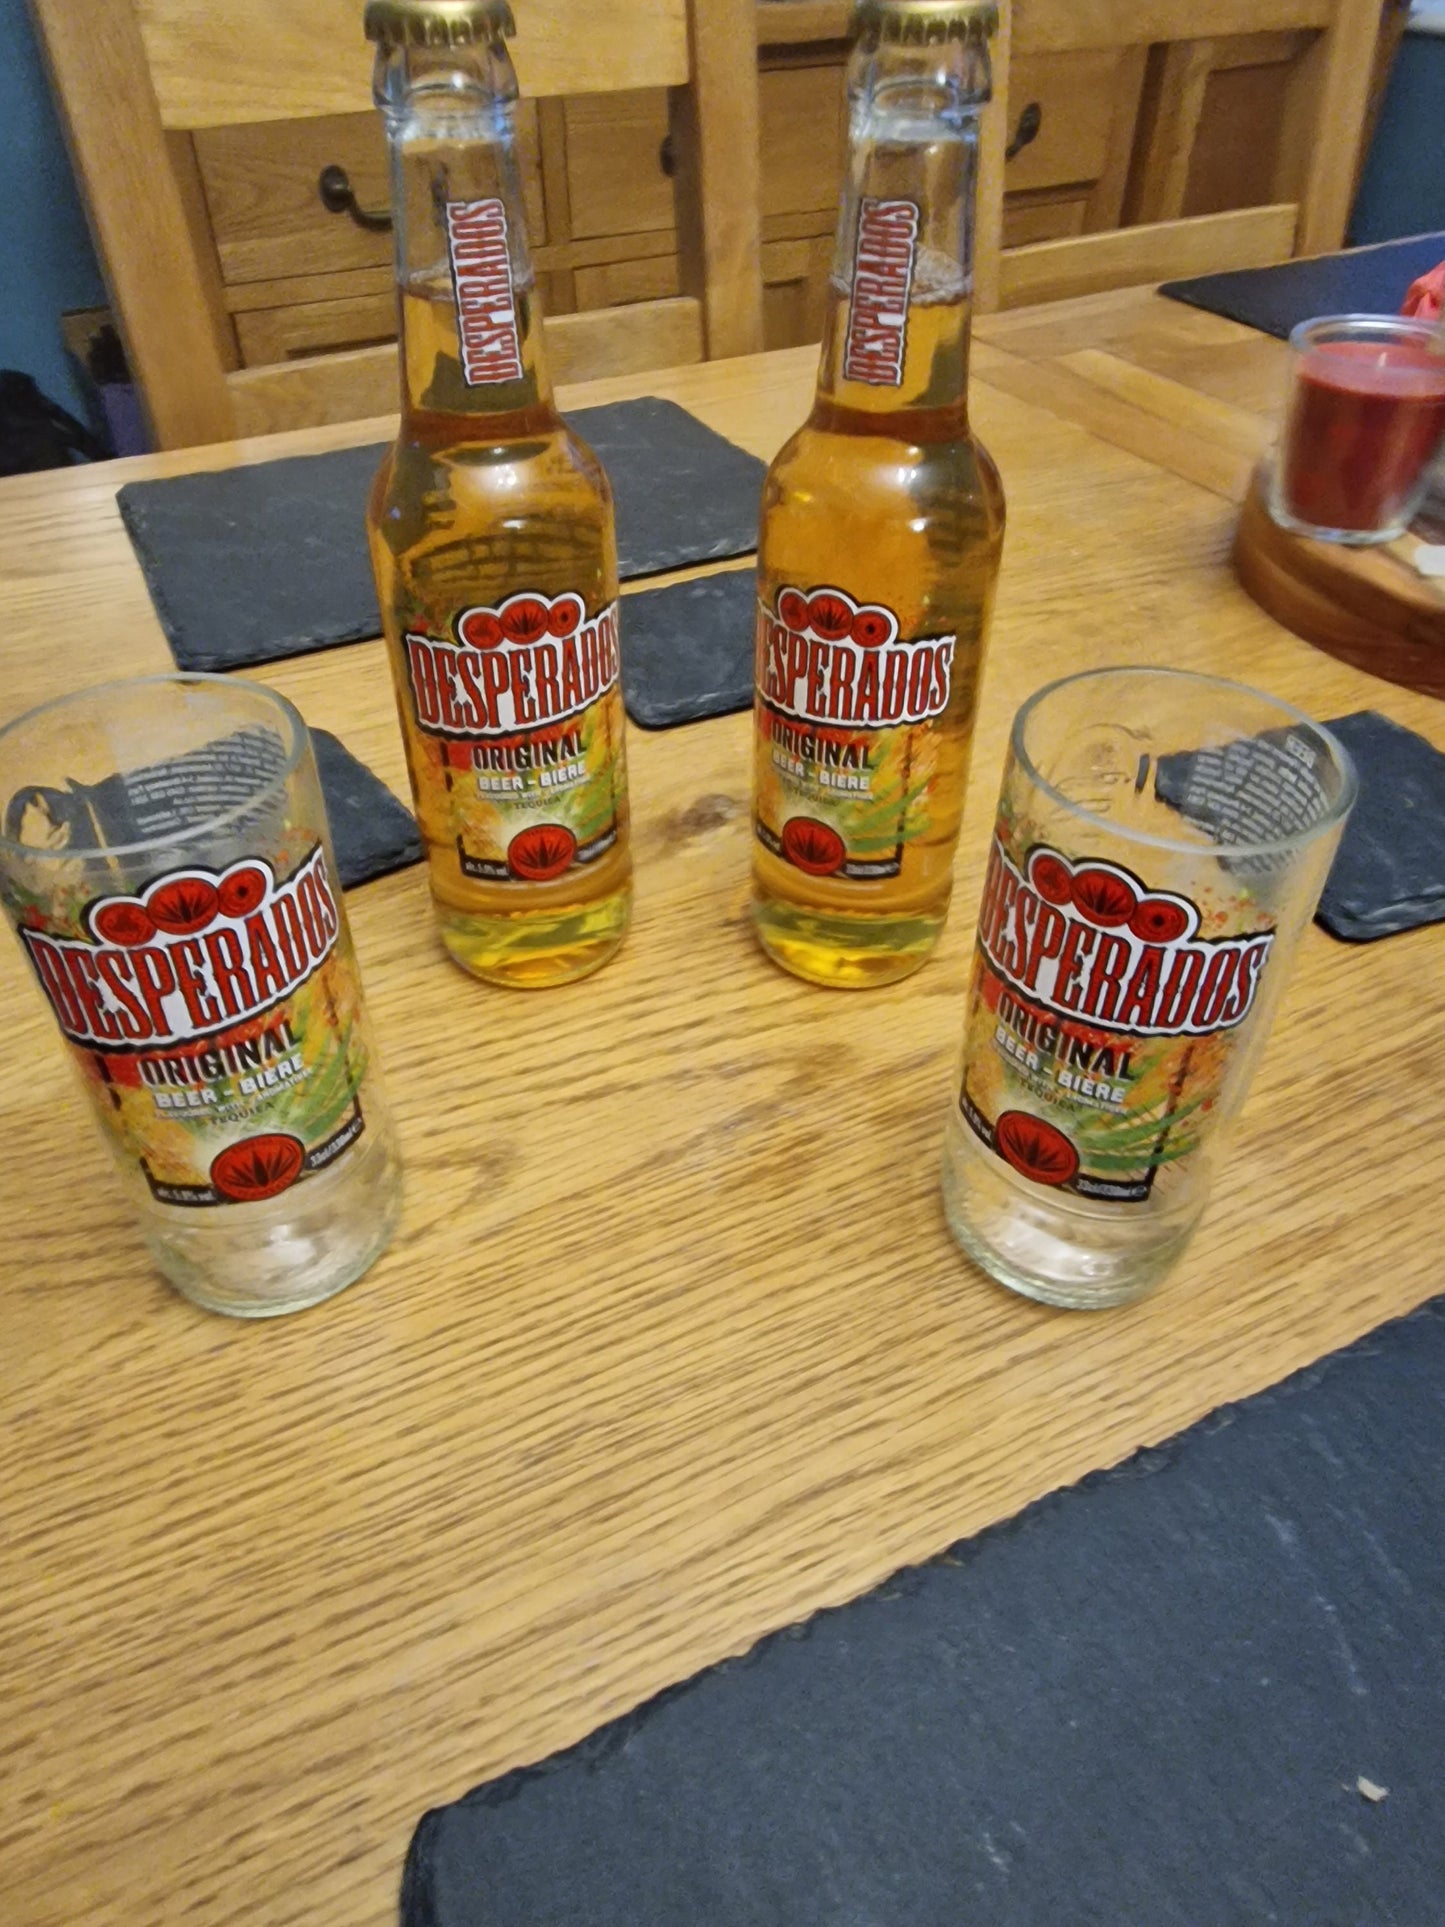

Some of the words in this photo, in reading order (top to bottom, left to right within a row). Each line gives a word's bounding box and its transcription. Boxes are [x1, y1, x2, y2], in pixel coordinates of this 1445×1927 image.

[449, 200, 520, 384] DESPERADOS
[849, 201, 919, 384] DESPERADOS
[409, 605, 619, 729] DESPERADOS
[473, 731, 587, 772] ORIGINAL
[771, 719, 875, 771] ORIGINAL
[772, 750, 805, 777] BEER
[479, 776, 523, 790] BEER
[26, 852, 339, 1040] DESPERADOS
[137, 1019, 302, 1087] ORIGINAL
[995, 1025, 1041, 1071] BEER
[997, 991, 1136, 1082] ORIGINAL
[154, 1087, 218, 1109] BEER
